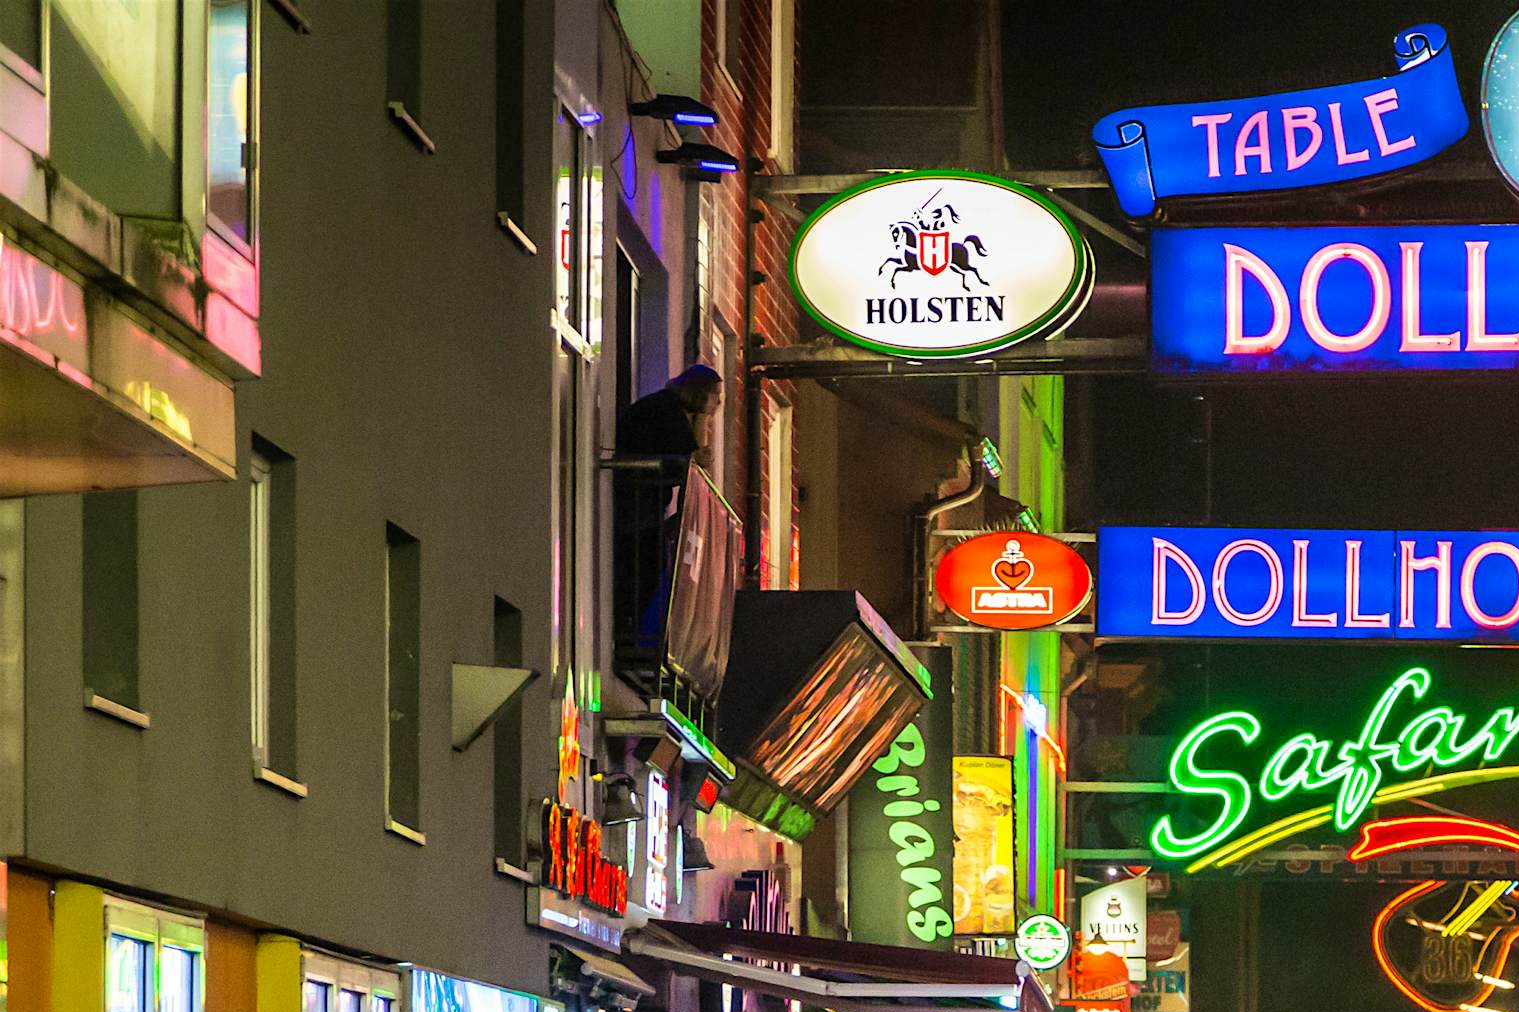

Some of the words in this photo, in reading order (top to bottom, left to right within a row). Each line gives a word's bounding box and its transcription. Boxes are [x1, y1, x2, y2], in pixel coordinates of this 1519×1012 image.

[1192, 88, 1416, 178] TABLE
[866, 295, 1006, 325] HOLSTEN
[978, 592, 1047, 608] ASTRA
[871, 722, 953, 943] Brians
